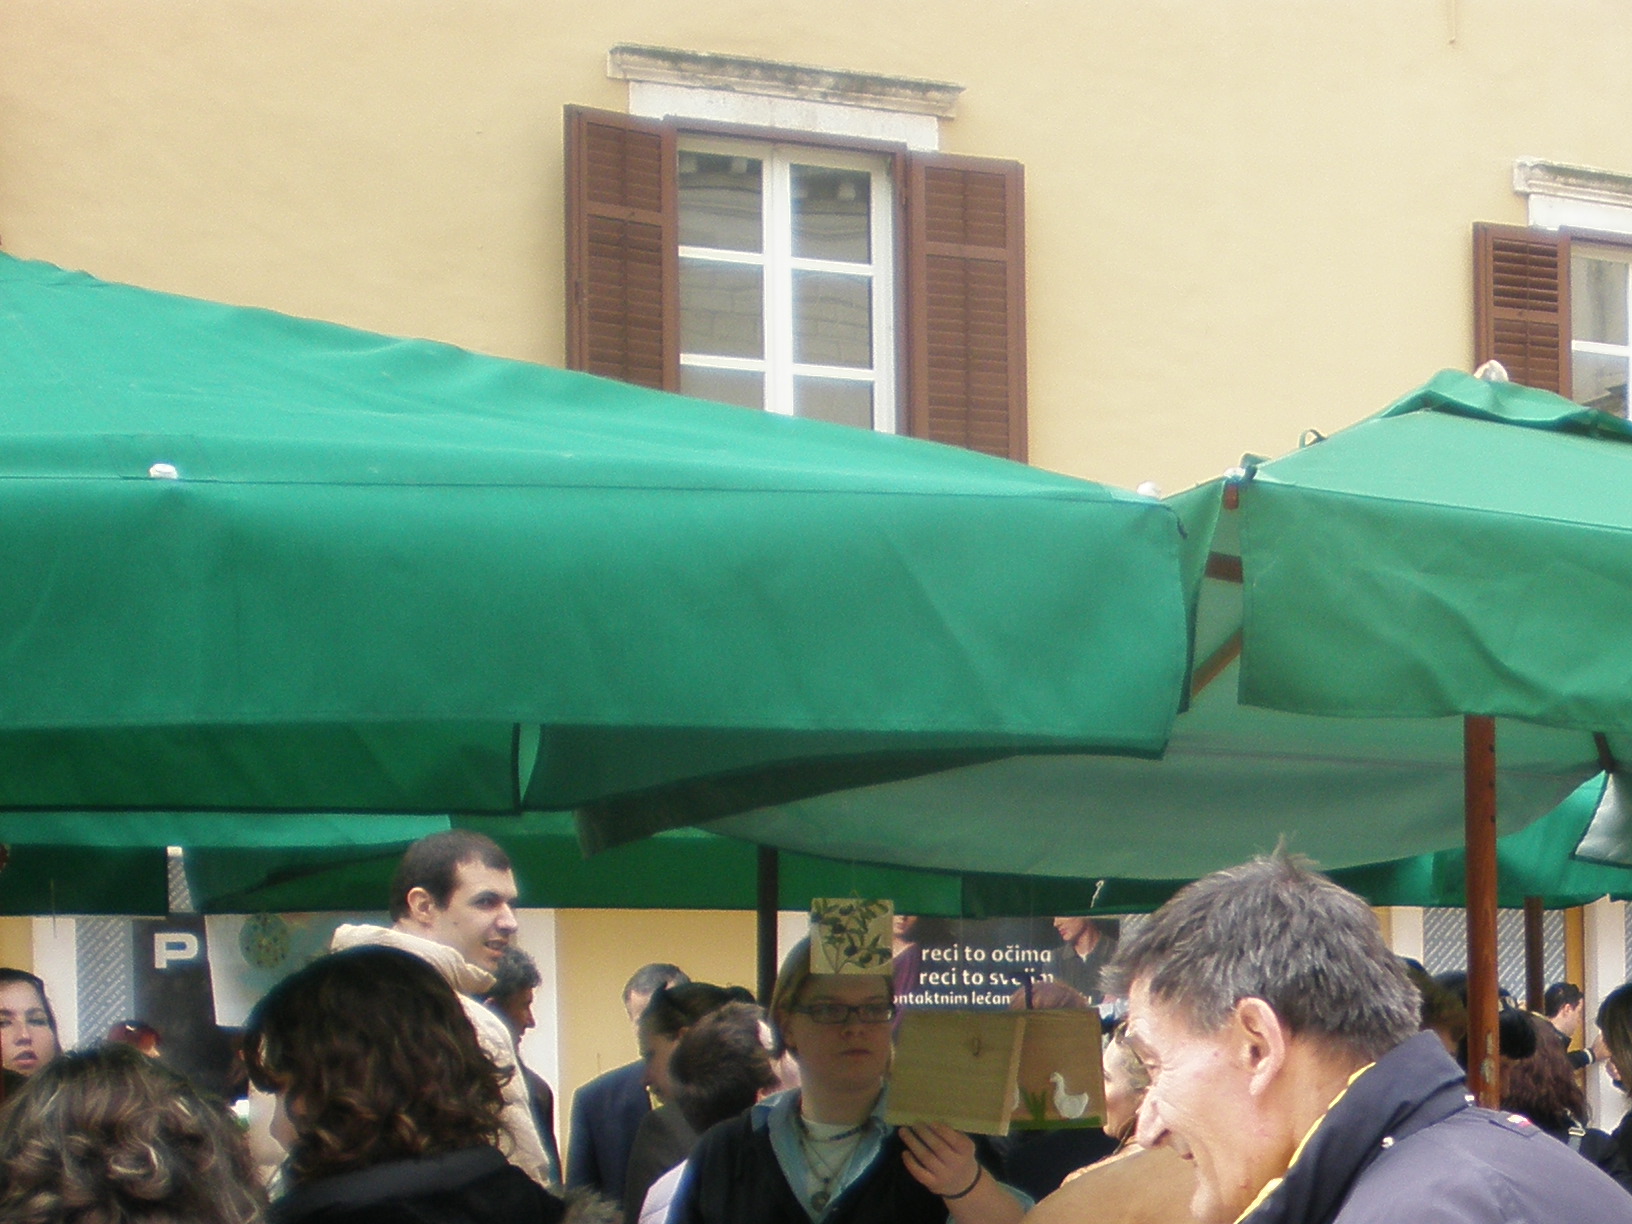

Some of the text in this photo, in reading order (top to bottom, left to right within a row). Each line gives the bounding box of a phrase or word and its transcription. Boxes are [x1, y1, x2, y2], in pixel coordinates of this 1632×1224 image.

[153, 932, 198, 969] P
[921, 944, 1052, 962] reci to očima
[919, 968, 956, 986] reci
[963, 969, 984, 986] to
